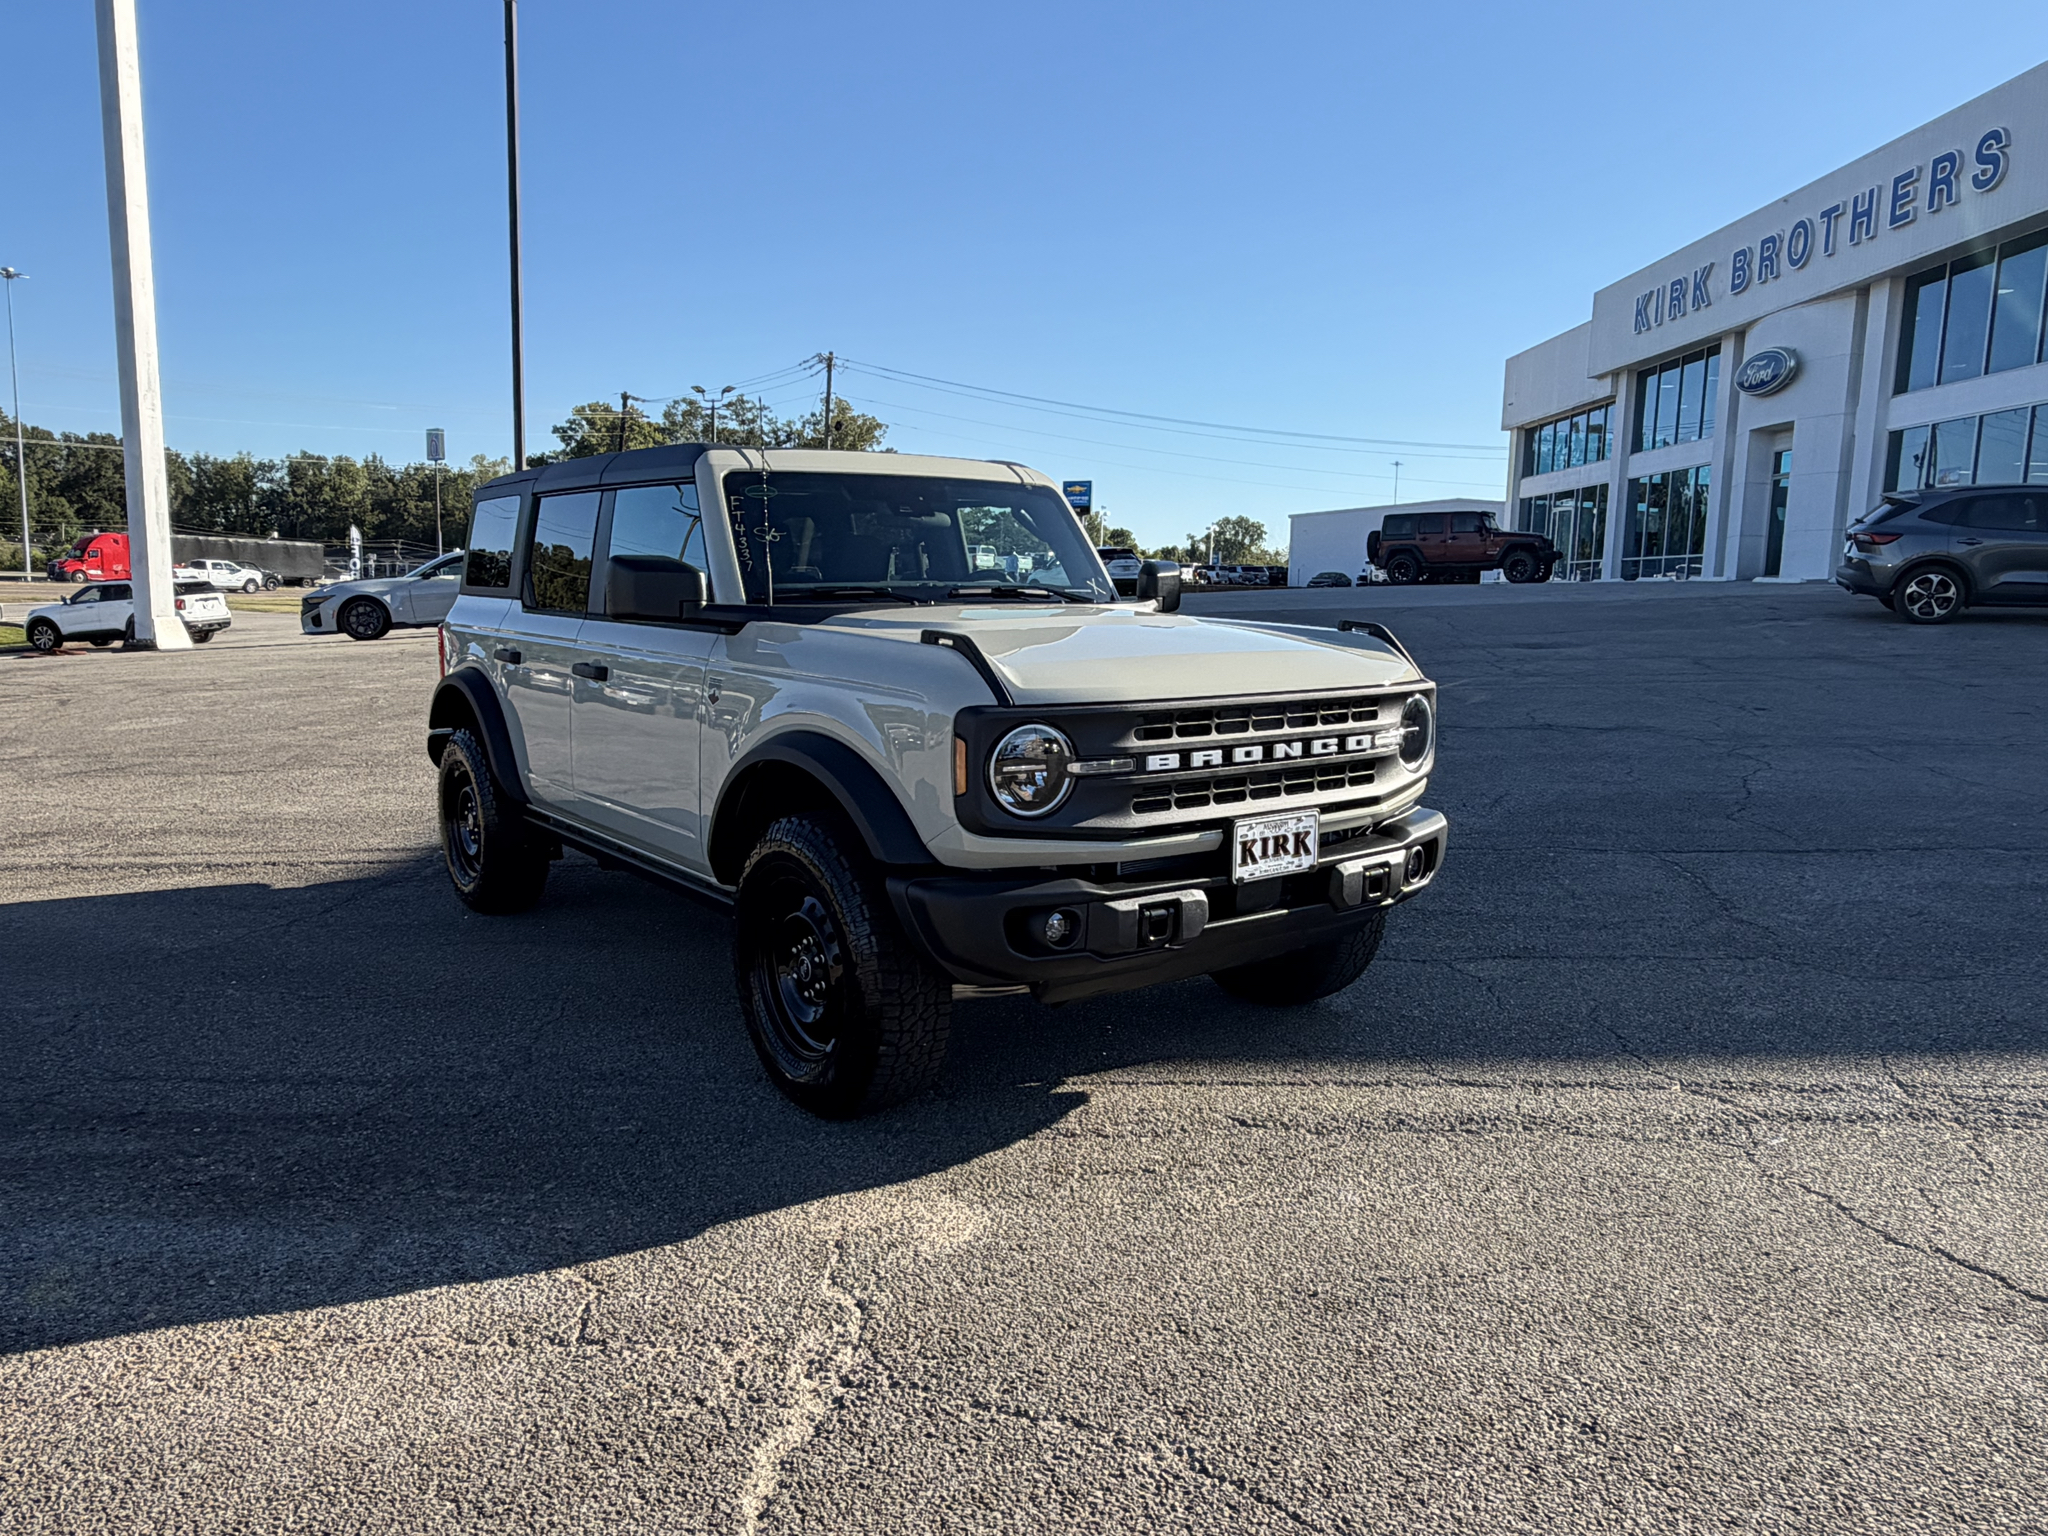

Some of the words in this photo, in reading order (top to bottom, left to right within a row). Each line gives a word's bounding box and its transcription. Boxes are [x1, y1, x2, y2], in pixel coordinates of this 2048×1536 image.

[1633, 261, 1716, 335] KIRK
[1729, 126, 2011, 295] BROTHERS
[1743, 359, 1775, 388] Ford
[1145, 734, 1372, 772] BRONCO
[1238, 830, 1312, 868] KIRK
